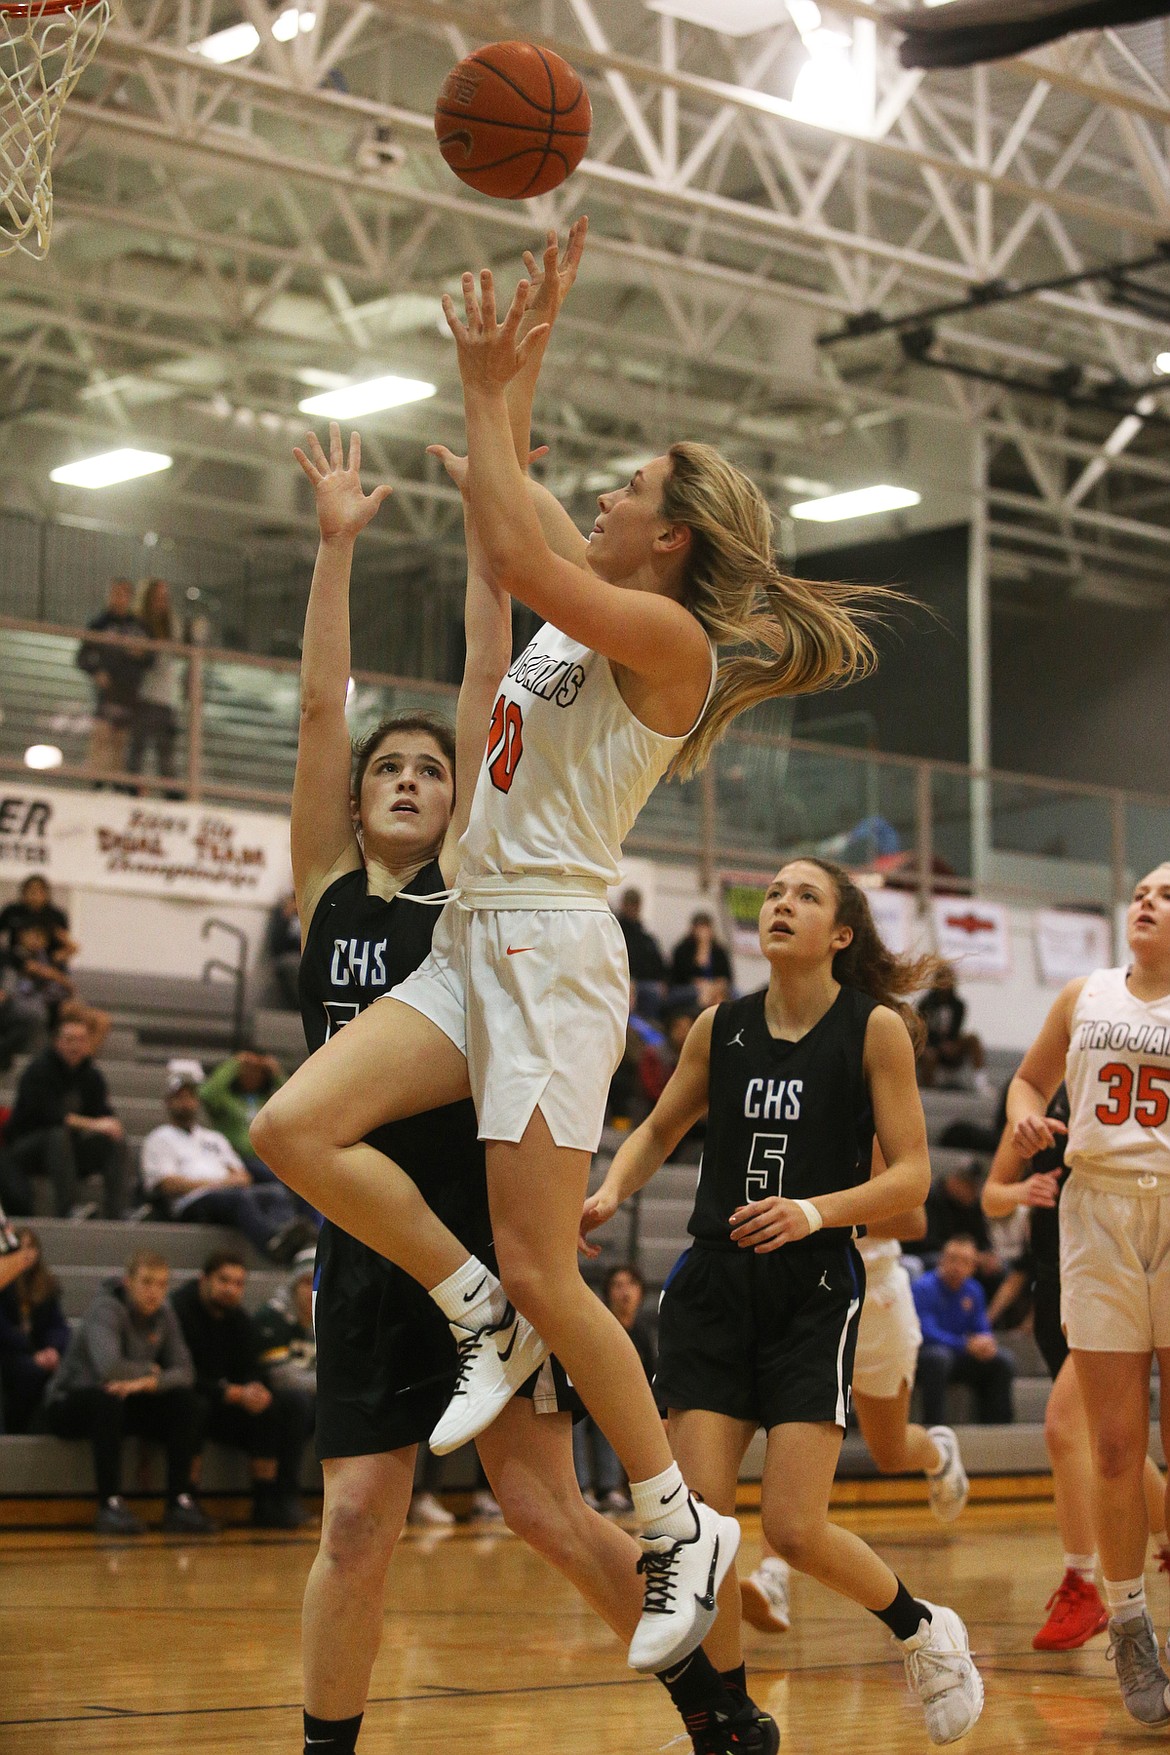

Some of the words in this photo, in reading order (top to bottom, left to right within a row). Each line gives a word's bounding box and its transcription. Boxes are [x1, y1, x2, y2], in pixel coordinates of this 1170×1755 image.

[330, 938, 387, 986] CHS
[744, 1078, 803, 1120] CHS
[1095, 1062, 1170, 1128] 35
[746, 1132, 788, 1203] 5
